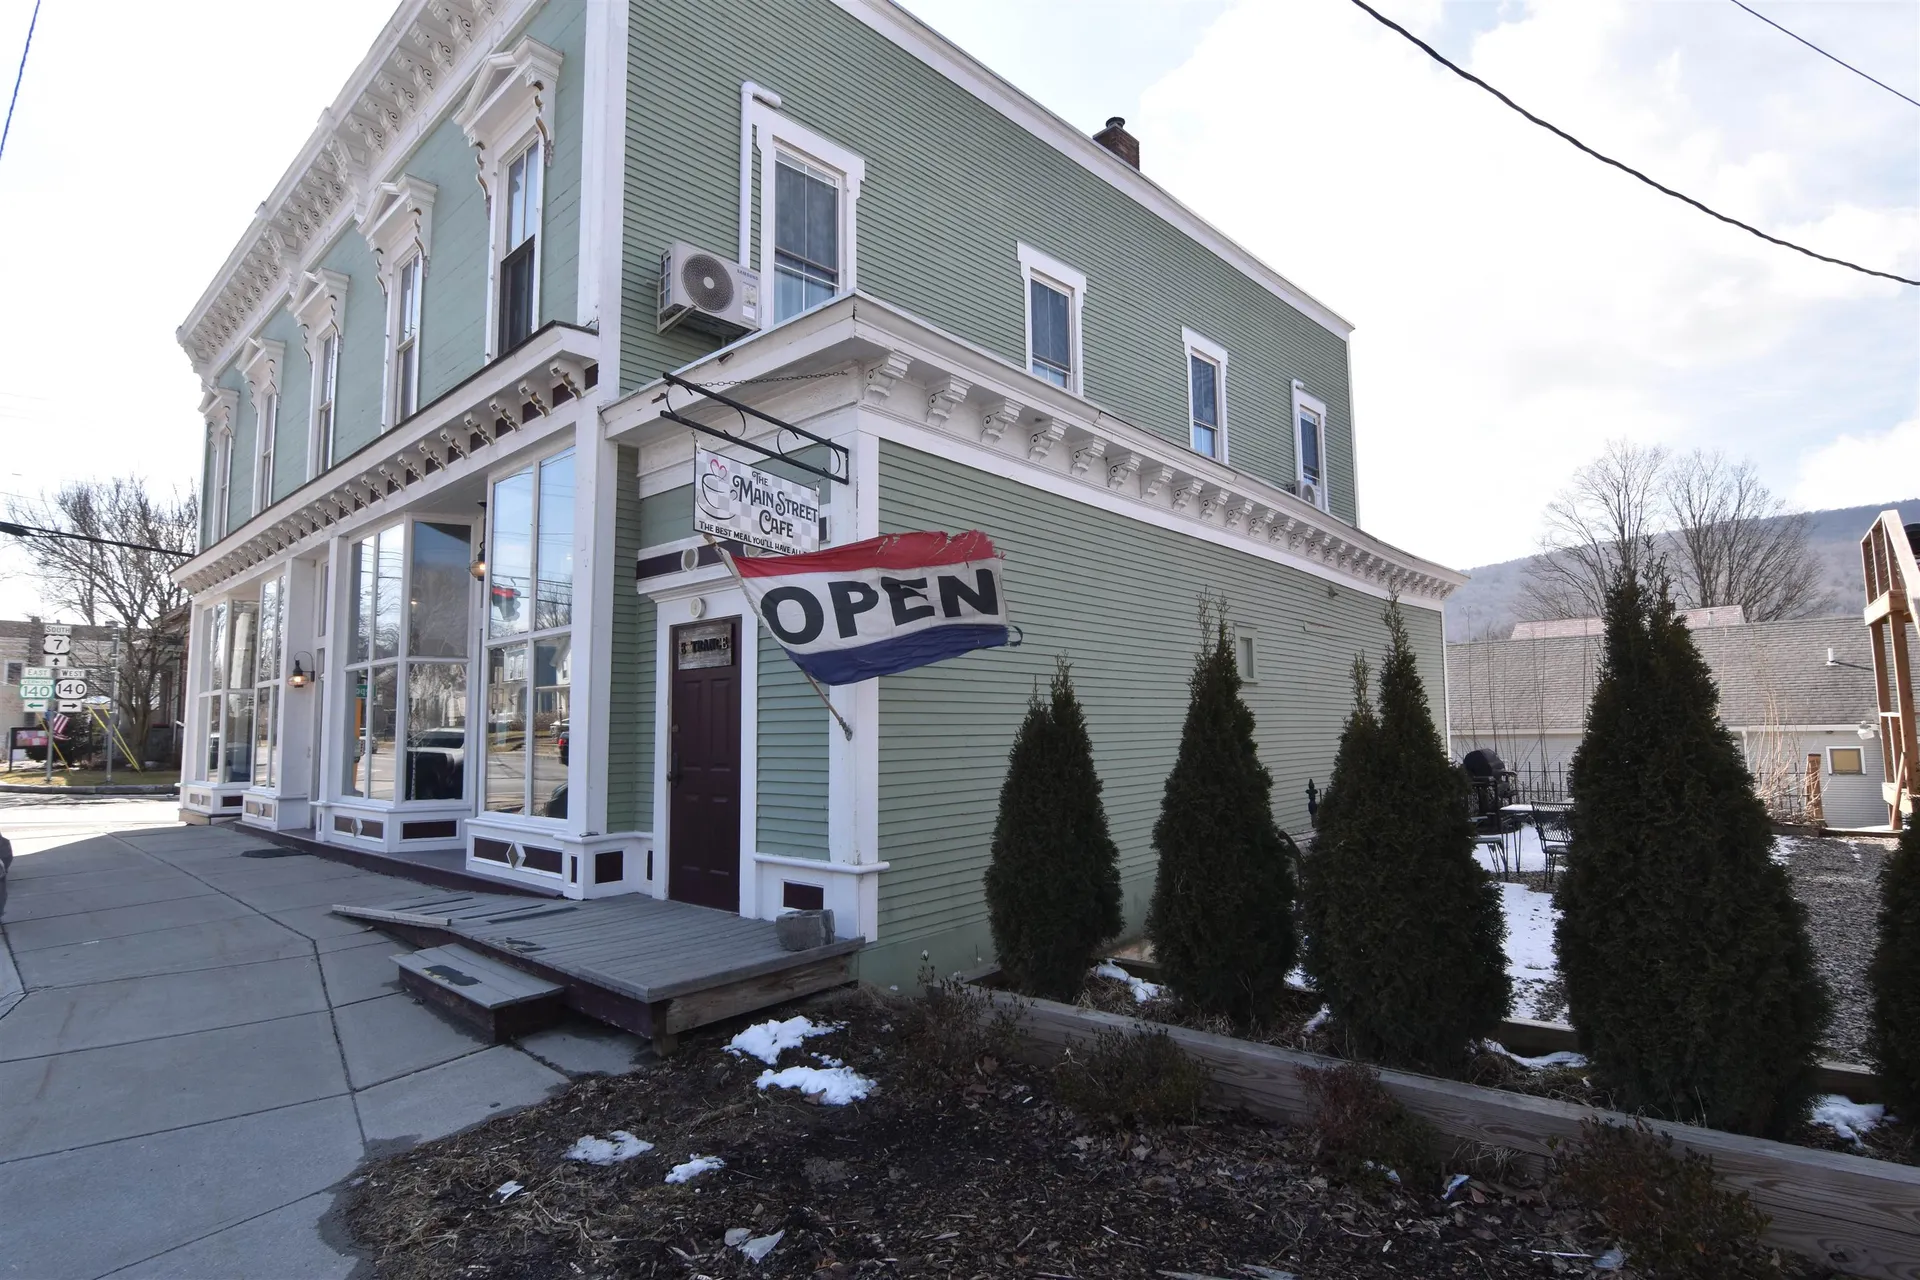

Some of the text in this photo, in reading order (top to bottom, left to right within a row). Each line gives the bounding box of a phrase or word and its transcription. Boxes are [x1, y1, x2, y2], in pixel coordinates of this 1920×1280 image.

[737, 269, 758, 280] SAMSUNG
[752, 471, 769, 486] THE
[732, 475, 818, 523] MAIN STREET
[759, 509, 794, 539] CAFE
[699, 520, 714, 532] THE
[715, 526, 732, 537] BEST
[733, 531, 752, 543] MEAL
[752, 536, 774, 549] YOU'LL
[774, 543, 791, 554] HAVE
[760, 568, 999, 645] OPEN
[46, 625, 71, 633] SOUTH
[53, 639, 63, 650] 7
[27, 668, 48, 676] EAST
[61, 669, 84, 677] WEST
[23, 686, 50, 697] 140
[57, 683, 86, 695] 140
